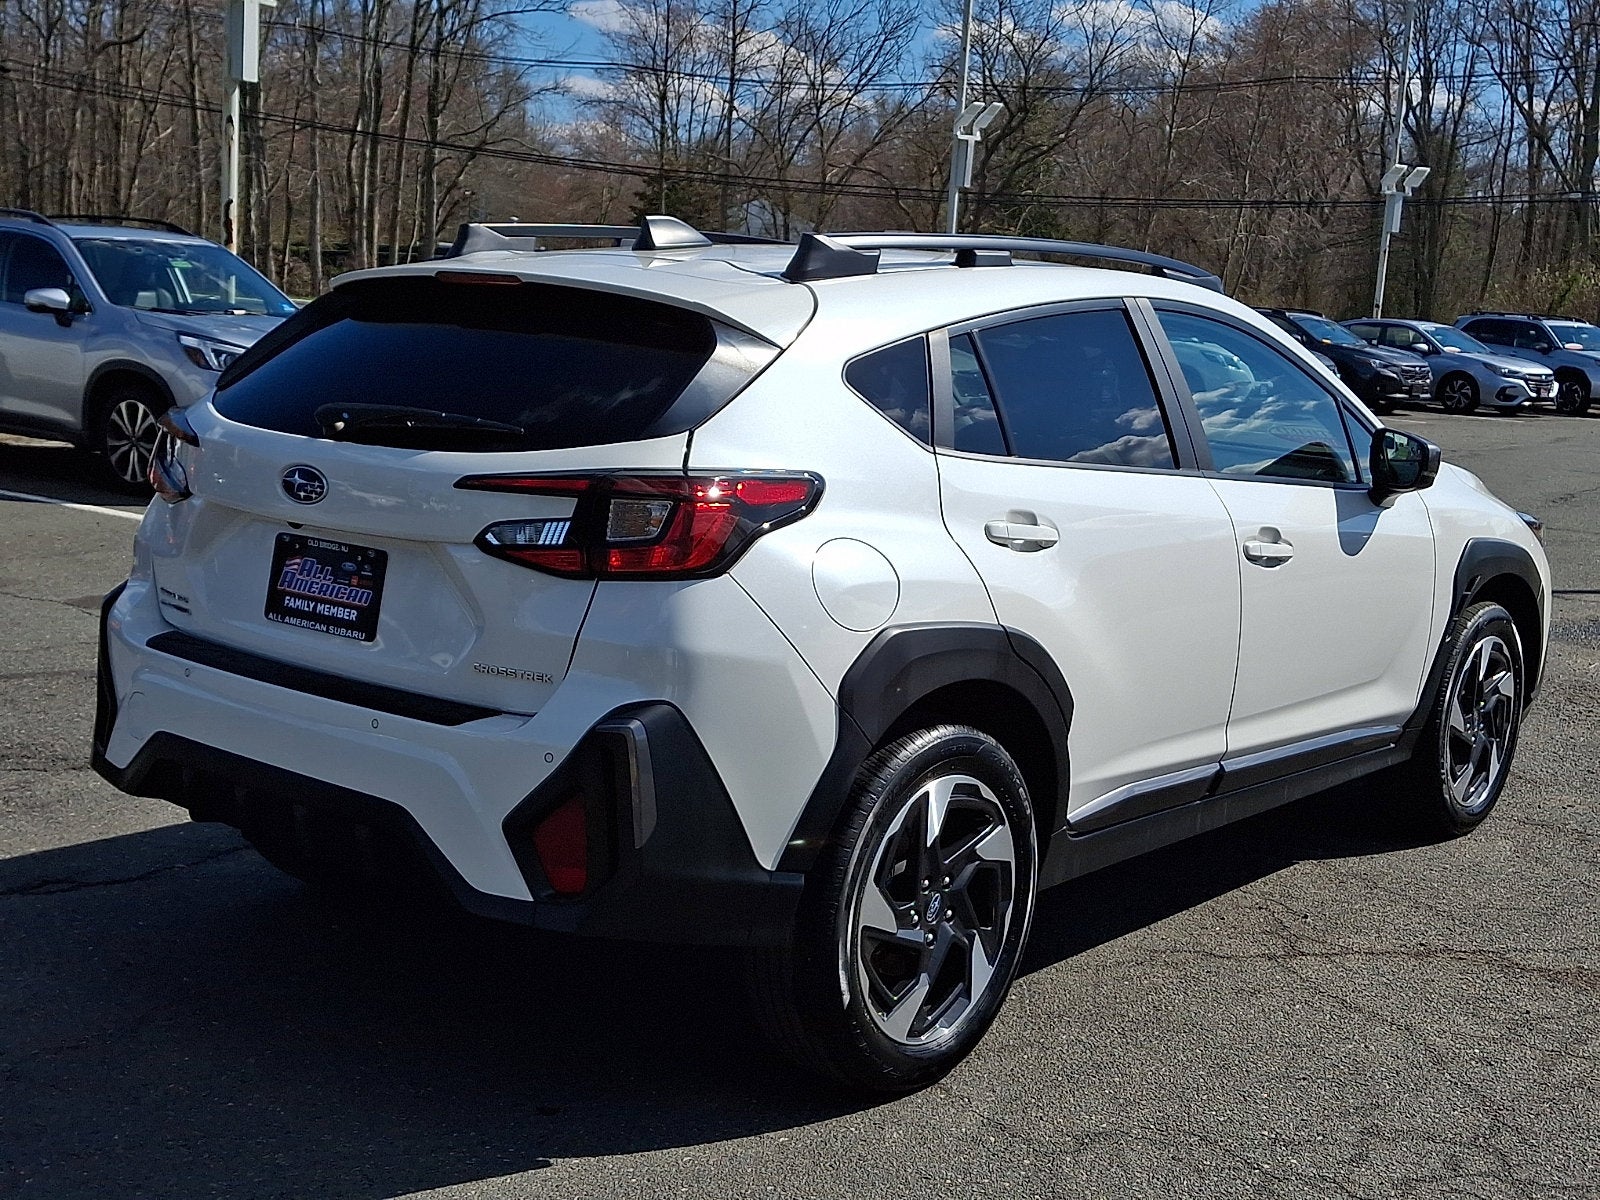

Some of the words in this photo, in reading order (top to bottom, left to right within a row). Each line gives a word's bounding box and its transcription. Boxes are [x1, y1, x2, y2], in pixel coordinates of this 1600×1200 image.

[297, 557, 334, 583] ALL
[277, 569, 373, 607] AMERICAN
[284, 596, 315, 612] FAMILY
[316, 602, 358, 621] MEMBER
[268, 612, 283, 622] ALL
[284, 615, 327, 632] AMERICAN
[328, 625, 366, 640] SUBARU
[473, 661, 553, 684] CROSSTREK
